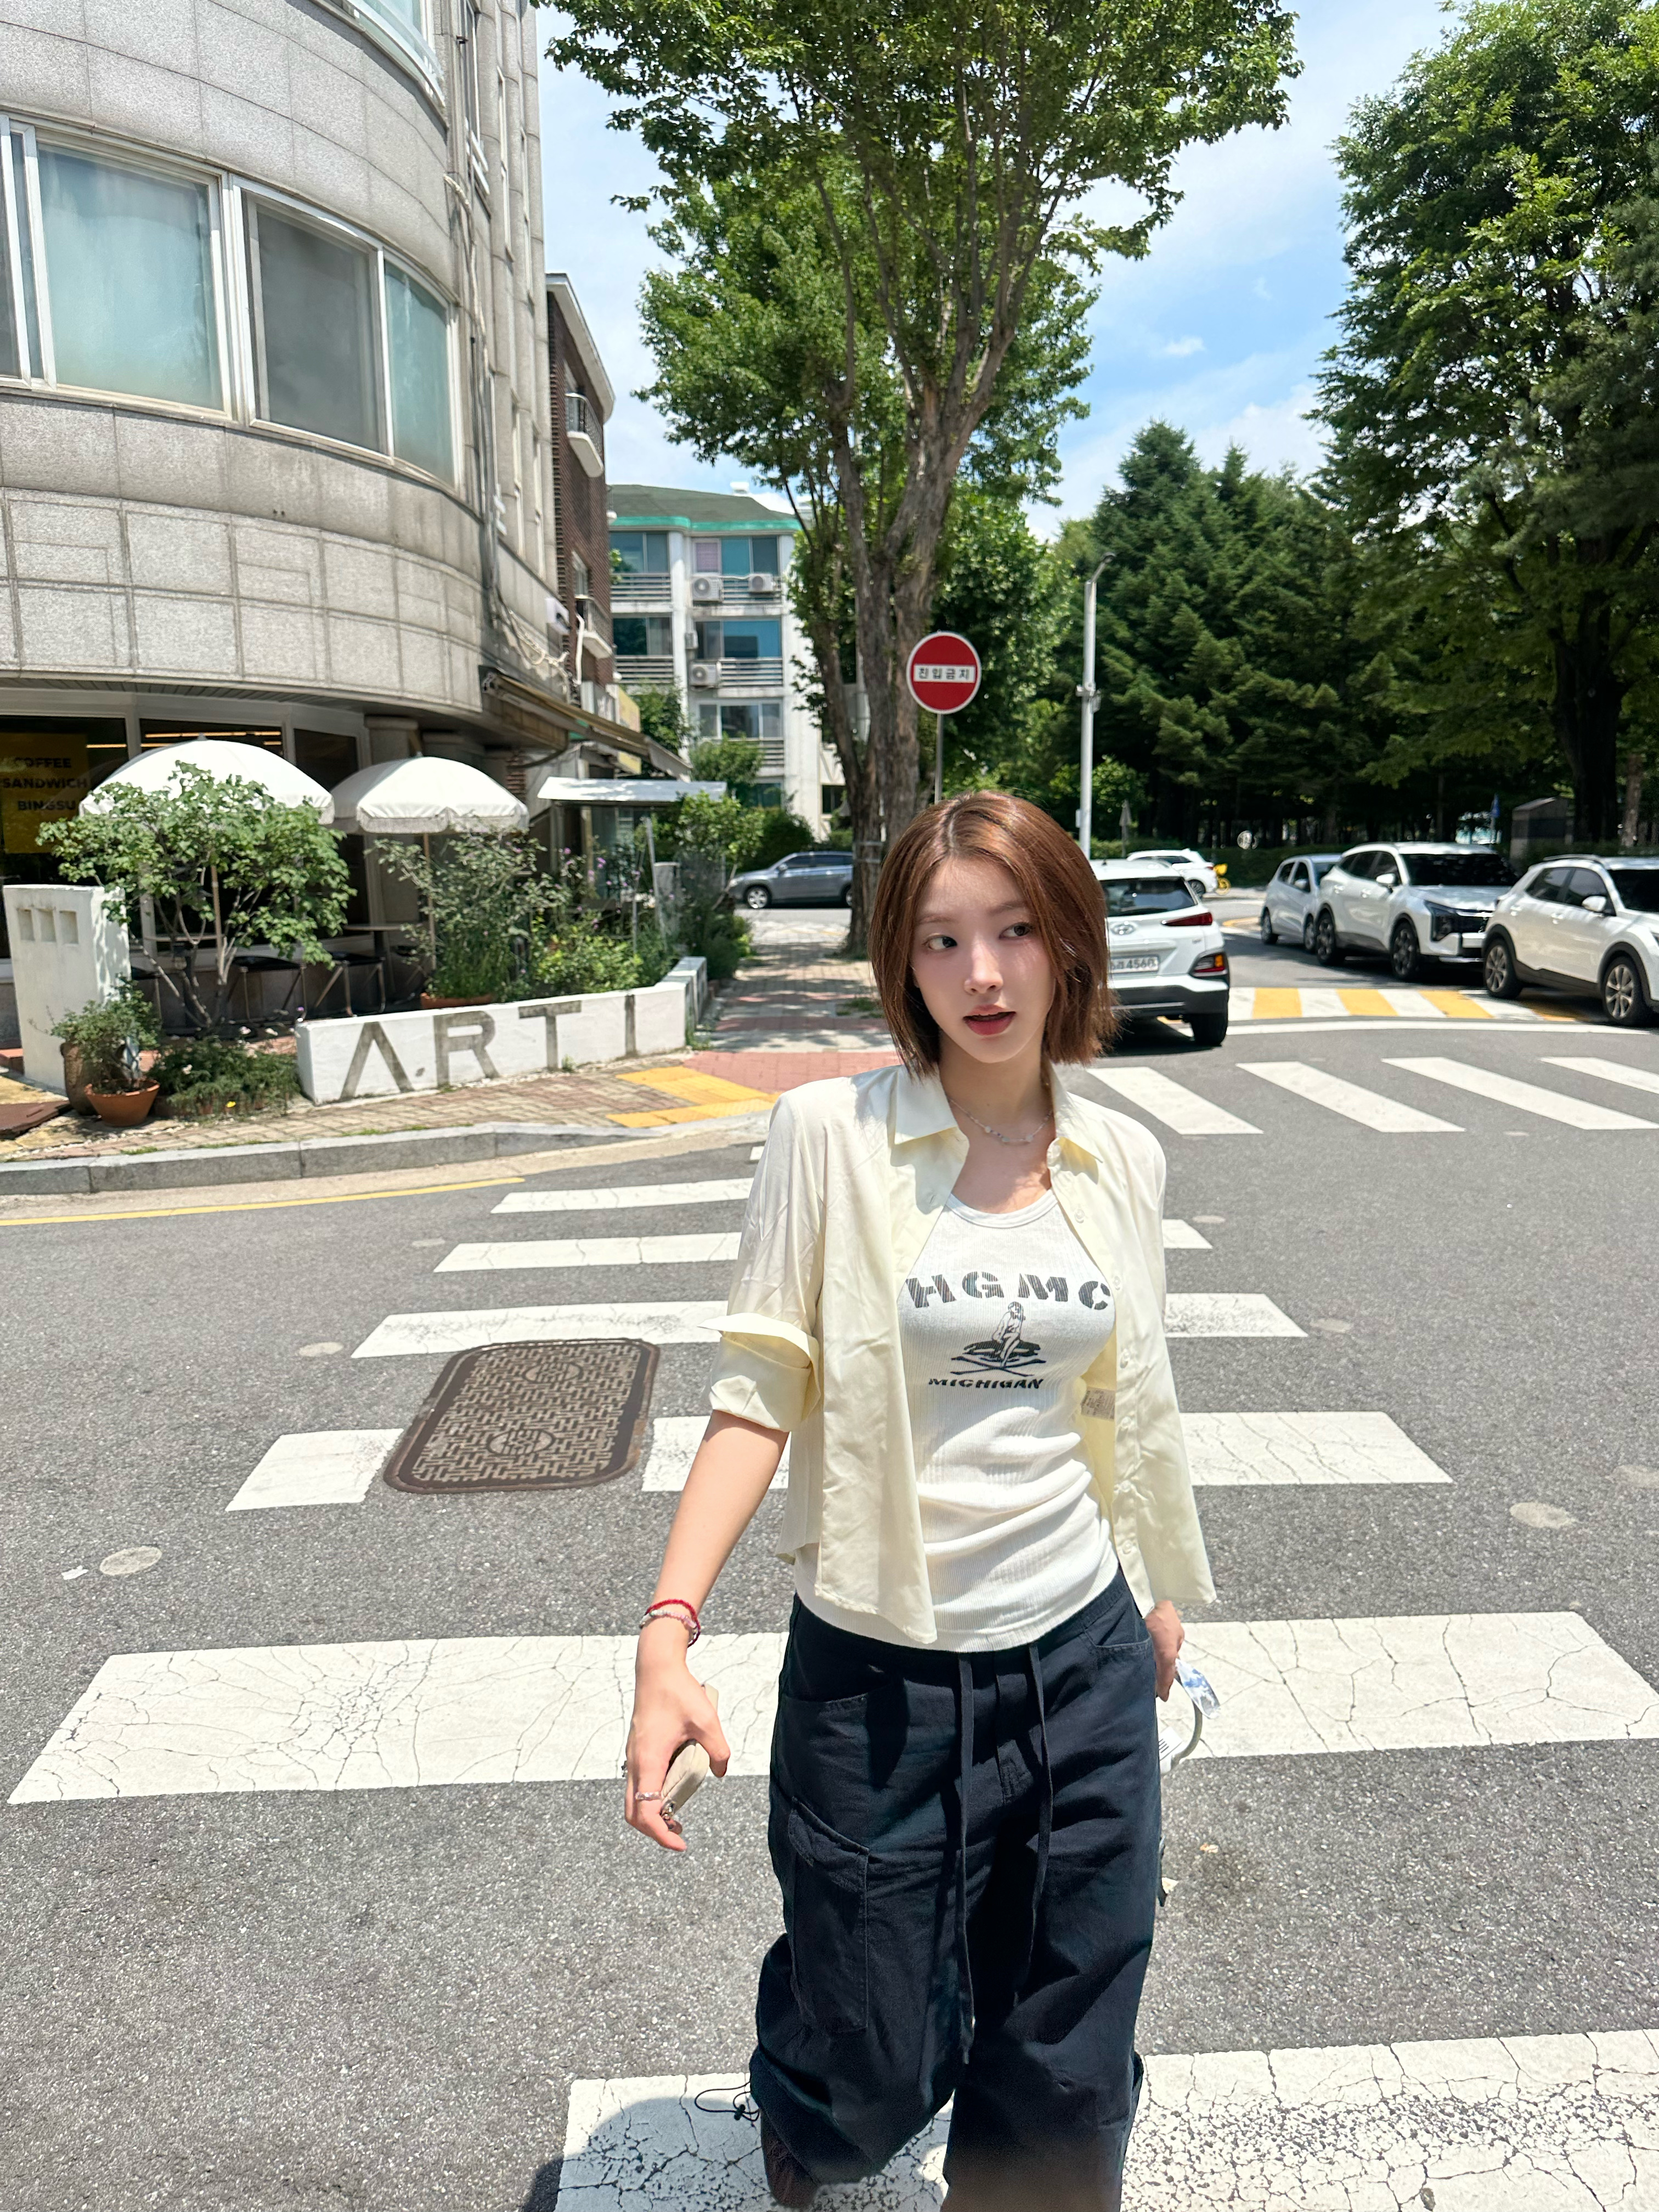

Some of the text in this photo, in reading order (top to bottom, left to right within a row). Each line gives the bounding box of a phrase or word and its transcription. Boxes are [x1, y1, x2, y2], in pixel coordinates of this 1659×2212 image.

[918, 667, 970, 680] 진입금지
[14, 758, 72, 768] COFFEE
[3, 778, 88, 788] SANDWICH
[18, 800, 76, 811] BINGSU
[905, 1271, 1111, 1310] HGMC
[929, 1378, 1044, 1389] MICHIGAN
